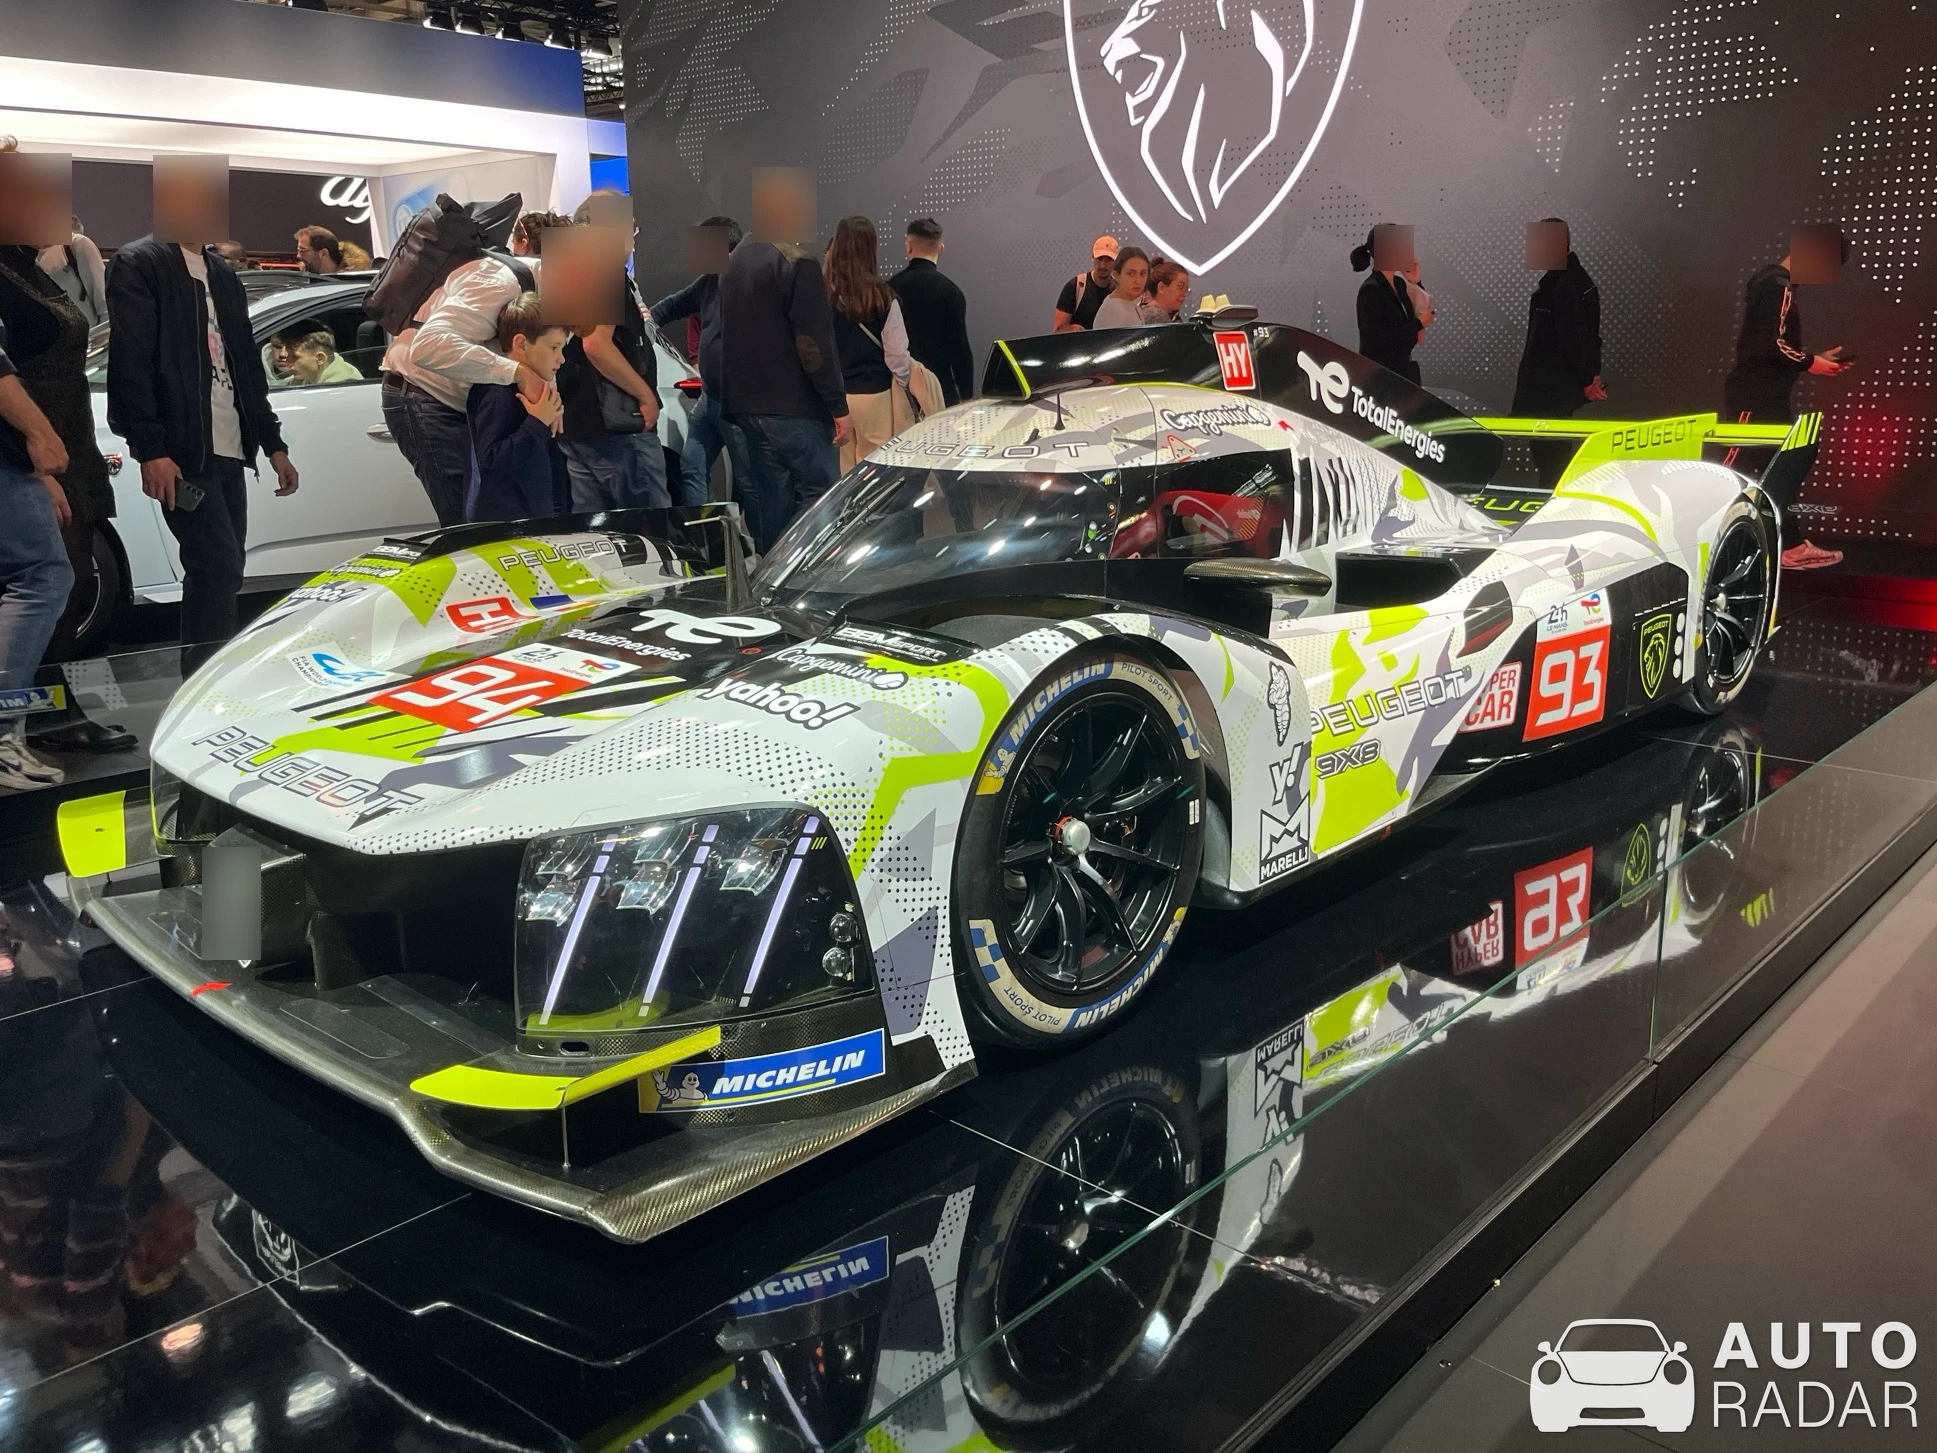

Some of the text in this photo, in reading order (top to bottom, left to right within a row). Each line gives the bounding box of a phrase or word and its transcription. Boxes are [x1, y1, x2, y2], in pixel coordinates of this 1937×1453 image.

[1219, 343, 1247, 378] HY
[1160, 404, 1250, 436] Capgemini
[1352, 386, 1445, 463] TotalEnergies
[1612, 420, 1696, 453] PEUGEOT
[498, 539, 627, 571] PEUGEOT
[560, 628, 691, 661] TotalEnergies
[774, 647, 880, 683] Capgemini
[1121, 662, 1173, 701] PILOT SPORT
[1535, 641, 1603, 726] 93
[390, 665, 556, 724] 94
[697, 677, 861, 730] yahoo!
[1008, 658, 1106, 745] MICHELIN
[1466, 690, 1513, 726] CAR
[191, 725, 425, 816] PEUGEOT
[1315, 738, 1380, 780] 9X8
[1261, 846, 1308, 880] MARELLI
[1004, 987, 1062, 1026] PILOT SPORT
[1074, 946, 1163, 1029] MICHELIN
[712, 1050, 866, 1094] MICHELIN
